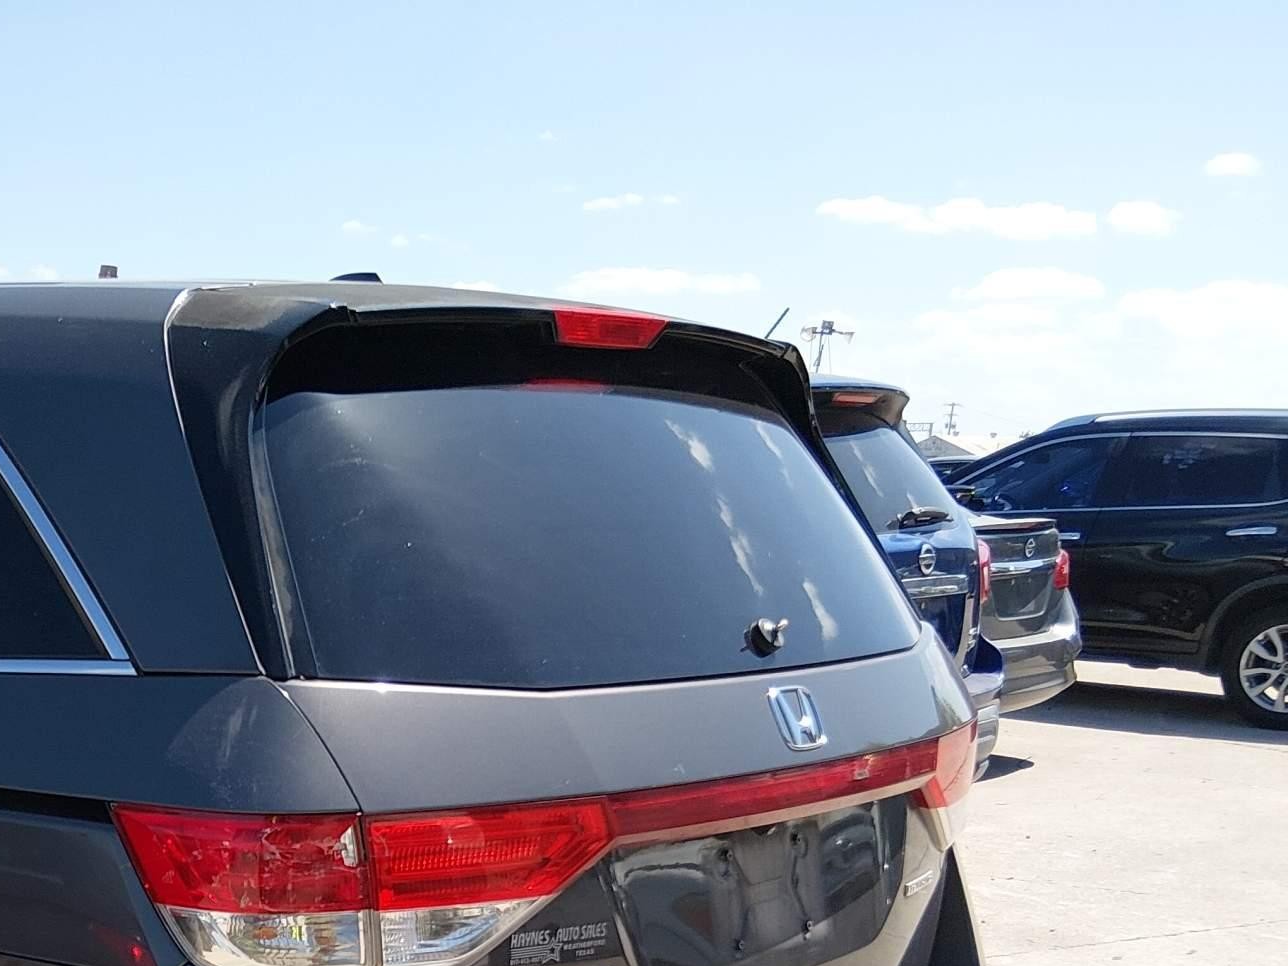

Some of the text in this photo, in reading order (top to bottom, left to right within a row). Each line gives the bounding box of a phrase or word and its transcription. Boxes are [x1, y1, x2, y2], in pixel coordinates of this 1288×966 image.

[510, 922, 607, 948] HAYNES AUTO SALES
